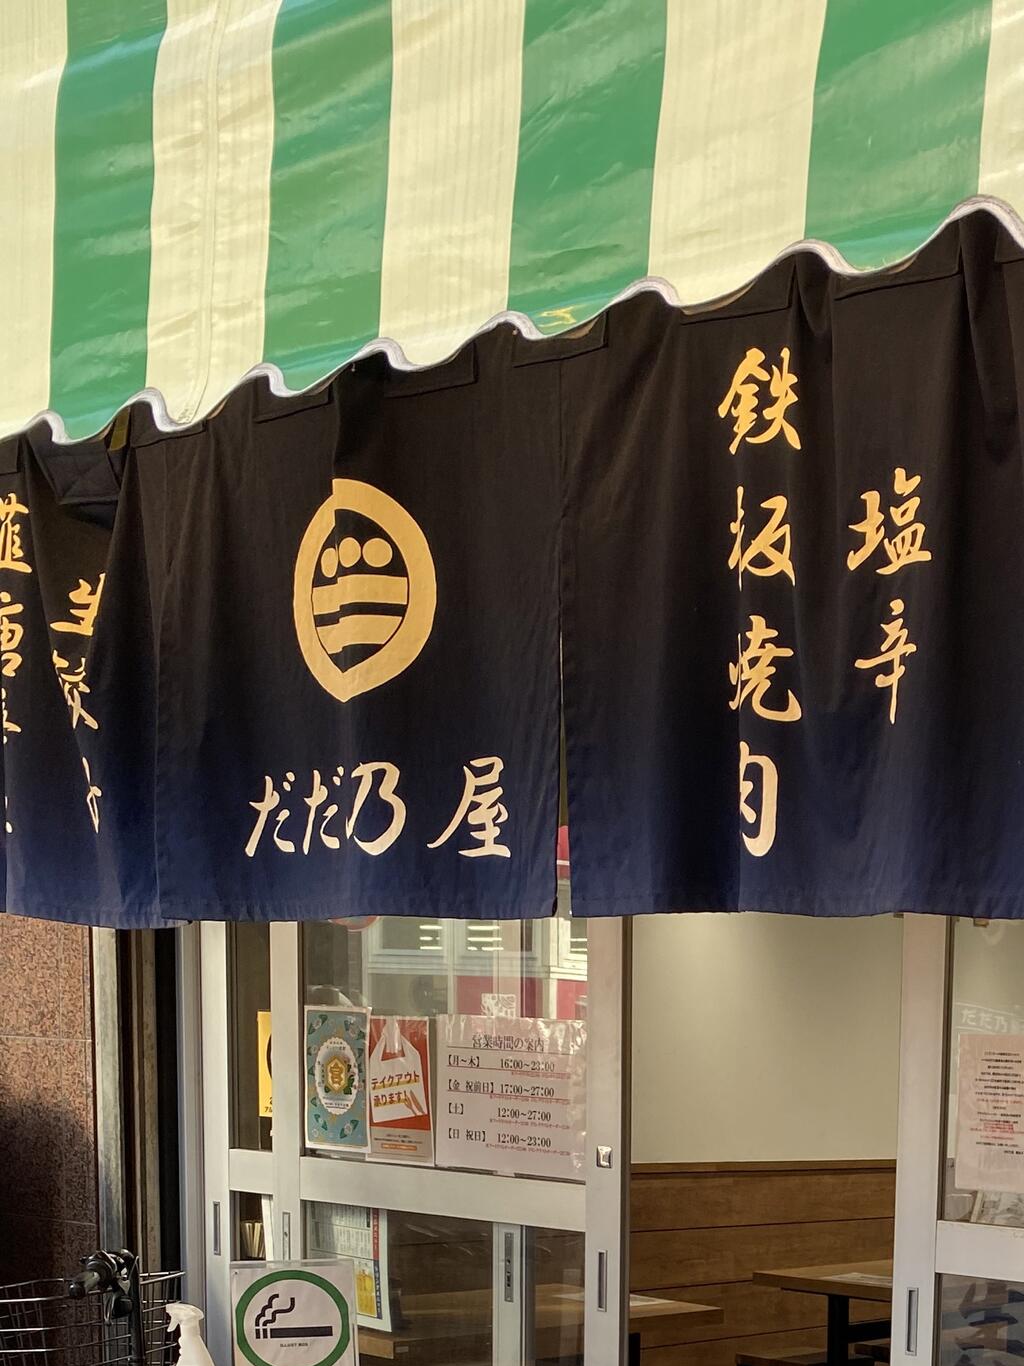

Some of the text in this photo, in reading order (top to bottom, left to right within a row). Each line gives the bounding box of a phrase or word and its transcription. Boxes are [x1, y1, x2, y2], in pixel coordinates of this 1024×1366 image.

[717, 348, 802, 857] 鉄板焼肉
[846, 468, 932, 724] 塩辛
[245, 757, 511, 858] だだ乃屋
[472, 1034, 544, 1052] 営業時間の案内
[371, 1071, 420, 1090] テイクアウト
[373, 1090, 408, 1106] 承ります！
